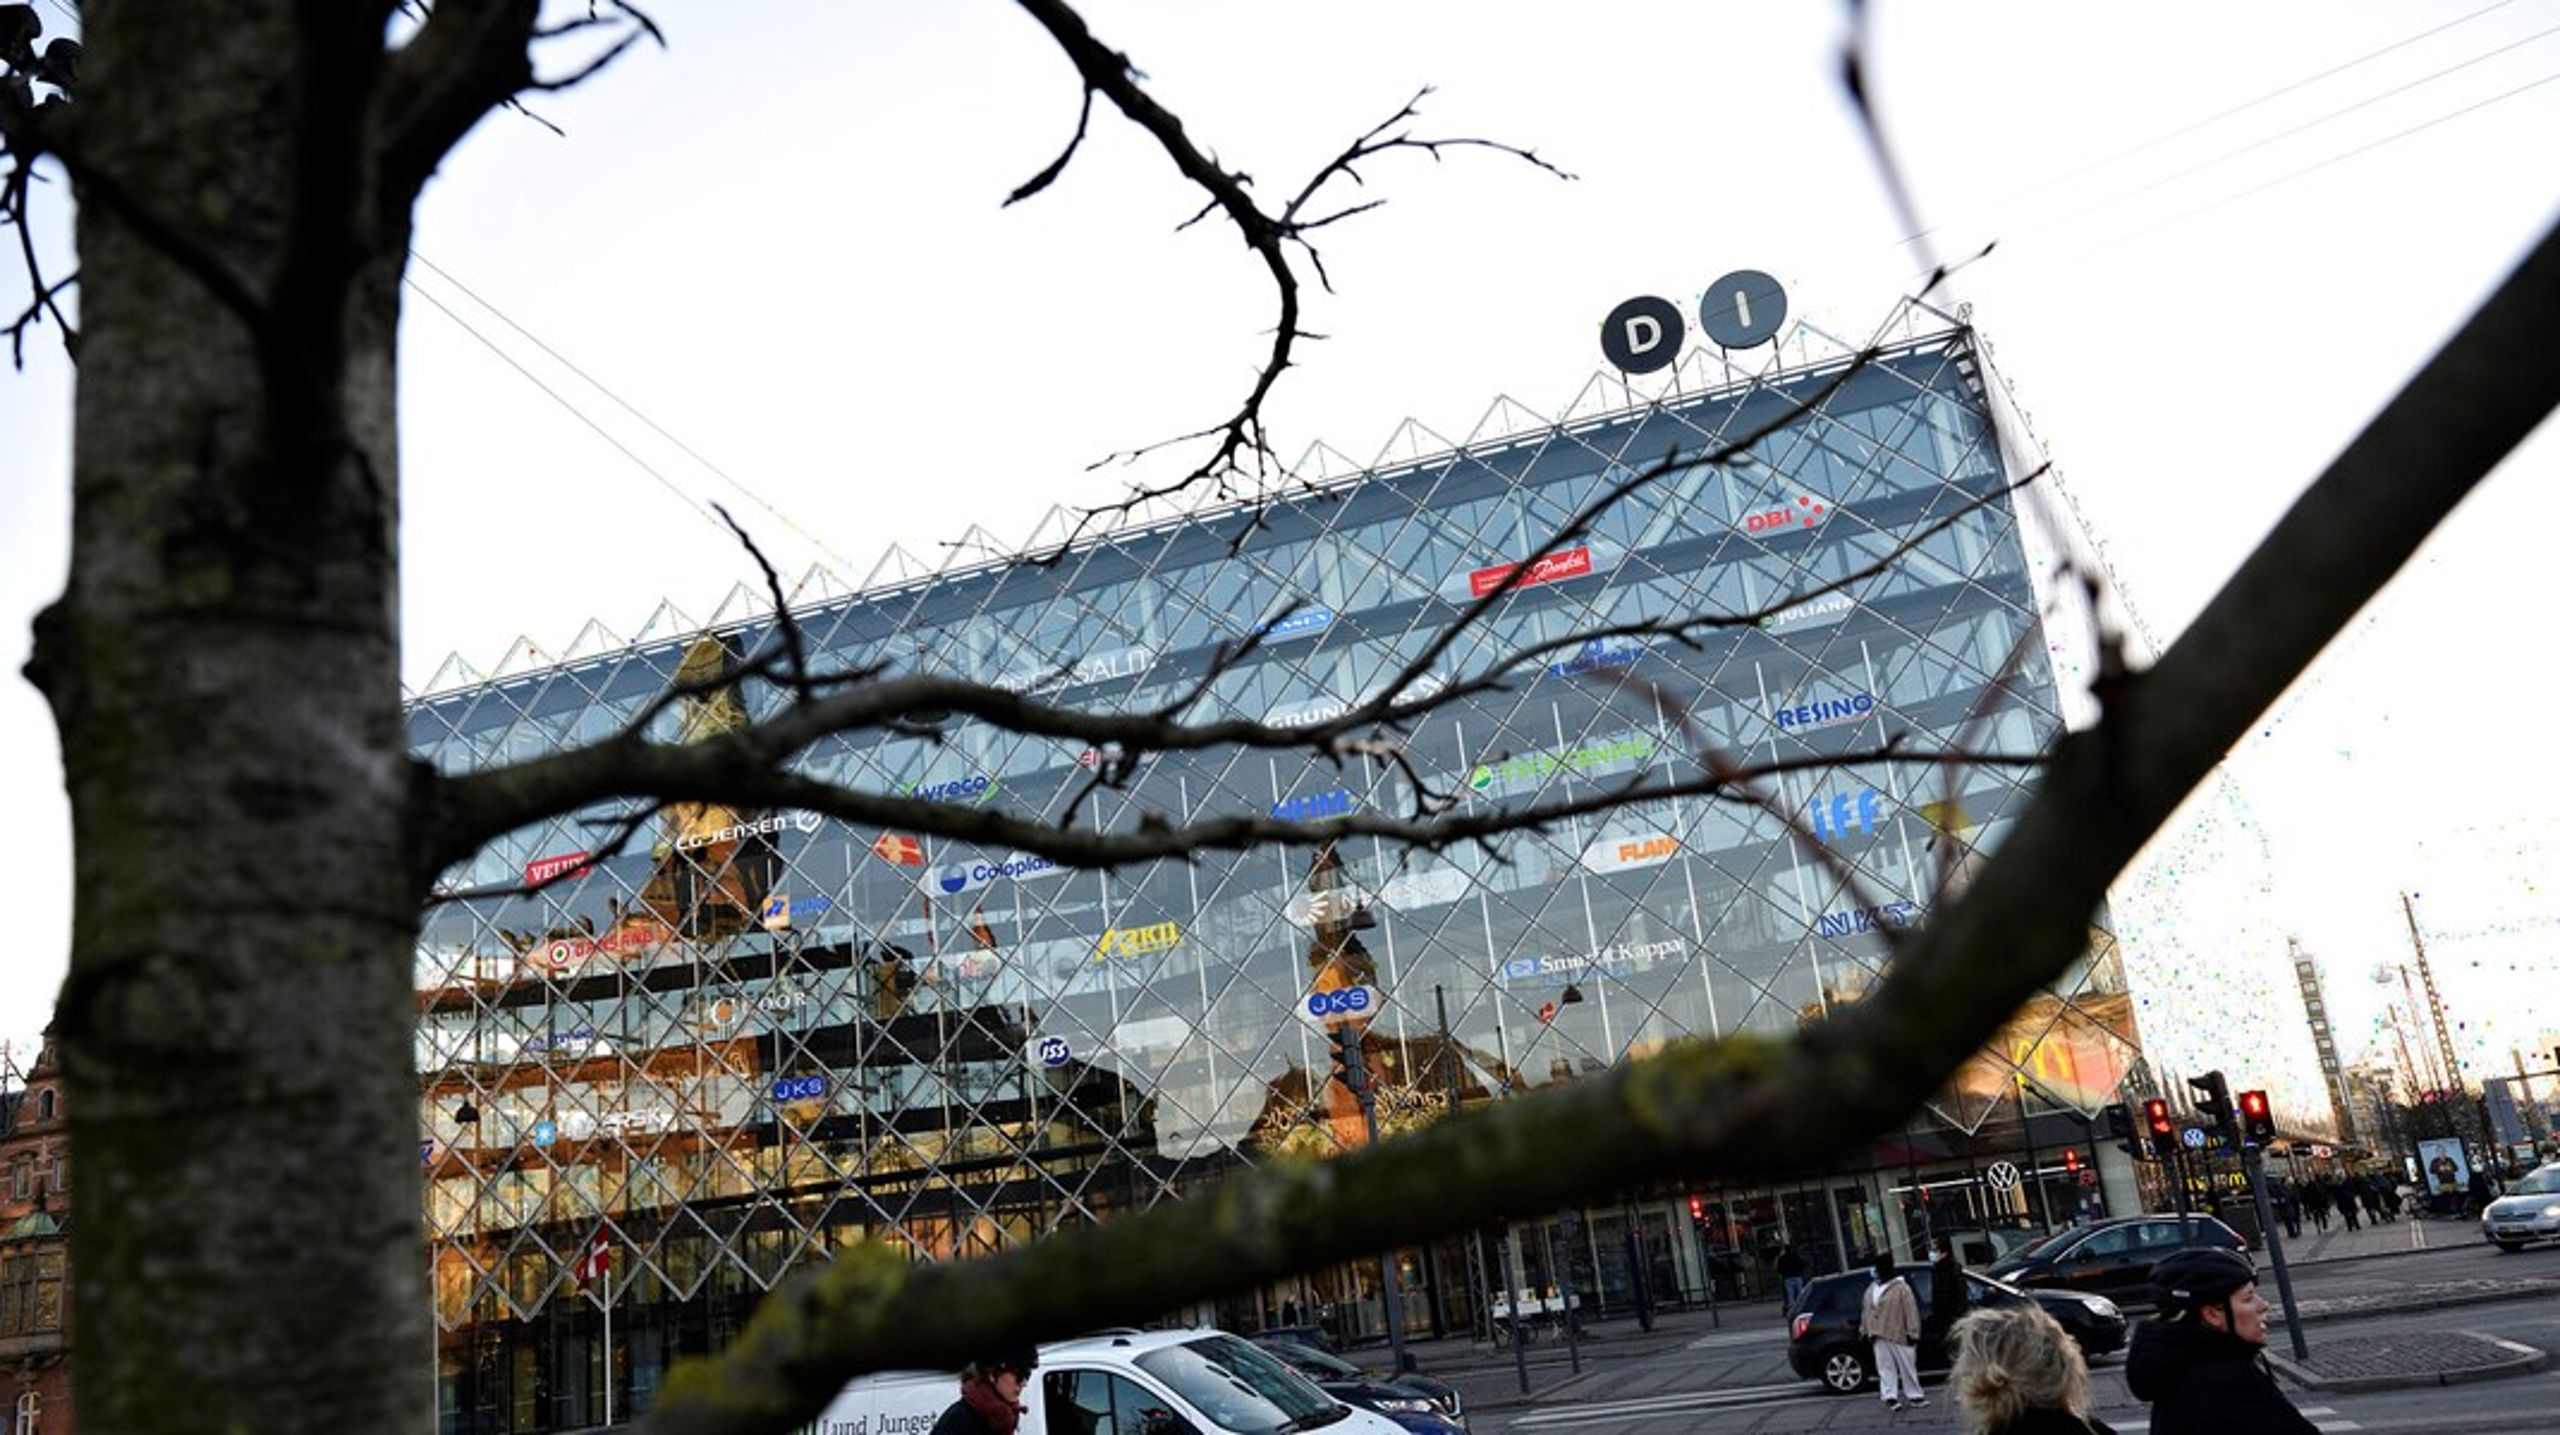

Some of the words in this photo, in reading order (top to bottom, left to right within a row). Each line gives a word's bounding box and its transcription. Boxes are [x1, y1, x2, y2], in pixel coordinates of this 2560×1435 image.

[1626, 315, 1662, 355] D
[1735, 290, 1752, 328] I
[1747, 507, 1792, 533] DBI
[1776, 598, 1856, 625] JULIANA
[1777, 693, 1872, 728] RESINO
[1811, 787, 1876, 842] iff
[708, 816, 785, 845] JENSEN
[973, 855, 1055, 881] Coloplas
[1820, 901, 1913, 939] NKT
[1619, 937, 1684, 962] Kappa
[1313, 990, 1366, 1012] JKS
[777, 1079, 821, 1098] JKS
